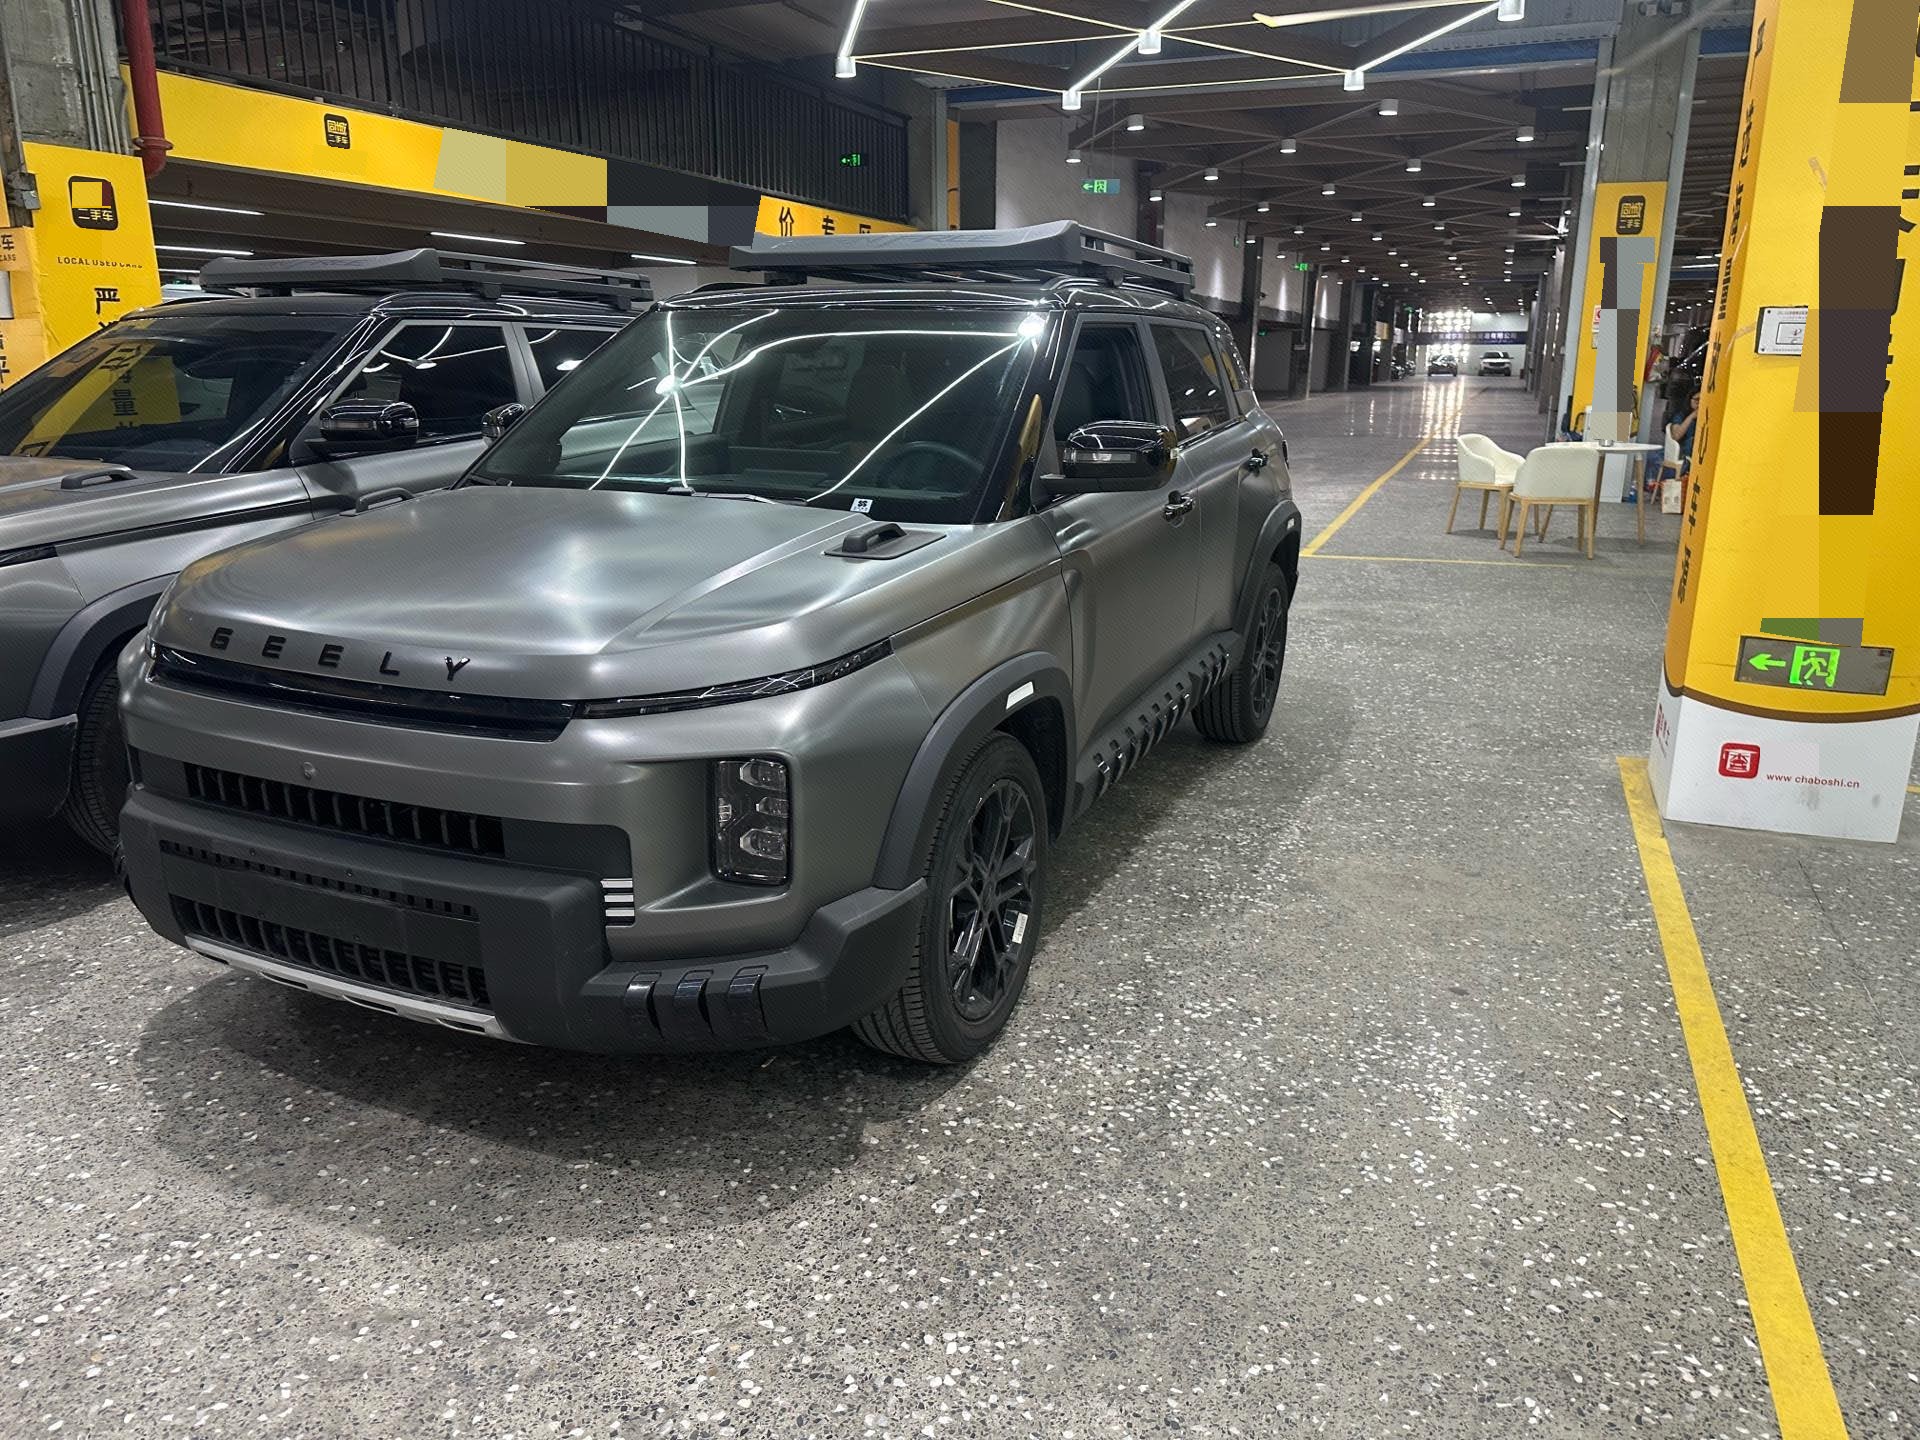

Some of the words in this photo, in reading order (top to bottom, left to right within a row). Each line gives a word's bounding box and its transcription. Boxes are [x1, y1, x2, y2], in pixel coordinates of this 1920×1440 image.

[77, 208, 114, 221] 二手车
[57, 256, 91, 265] LOCAL
[209, 626, 471, 682] GEELY
[1766, 773, 1860, 788] wwwchaboshi.cn
